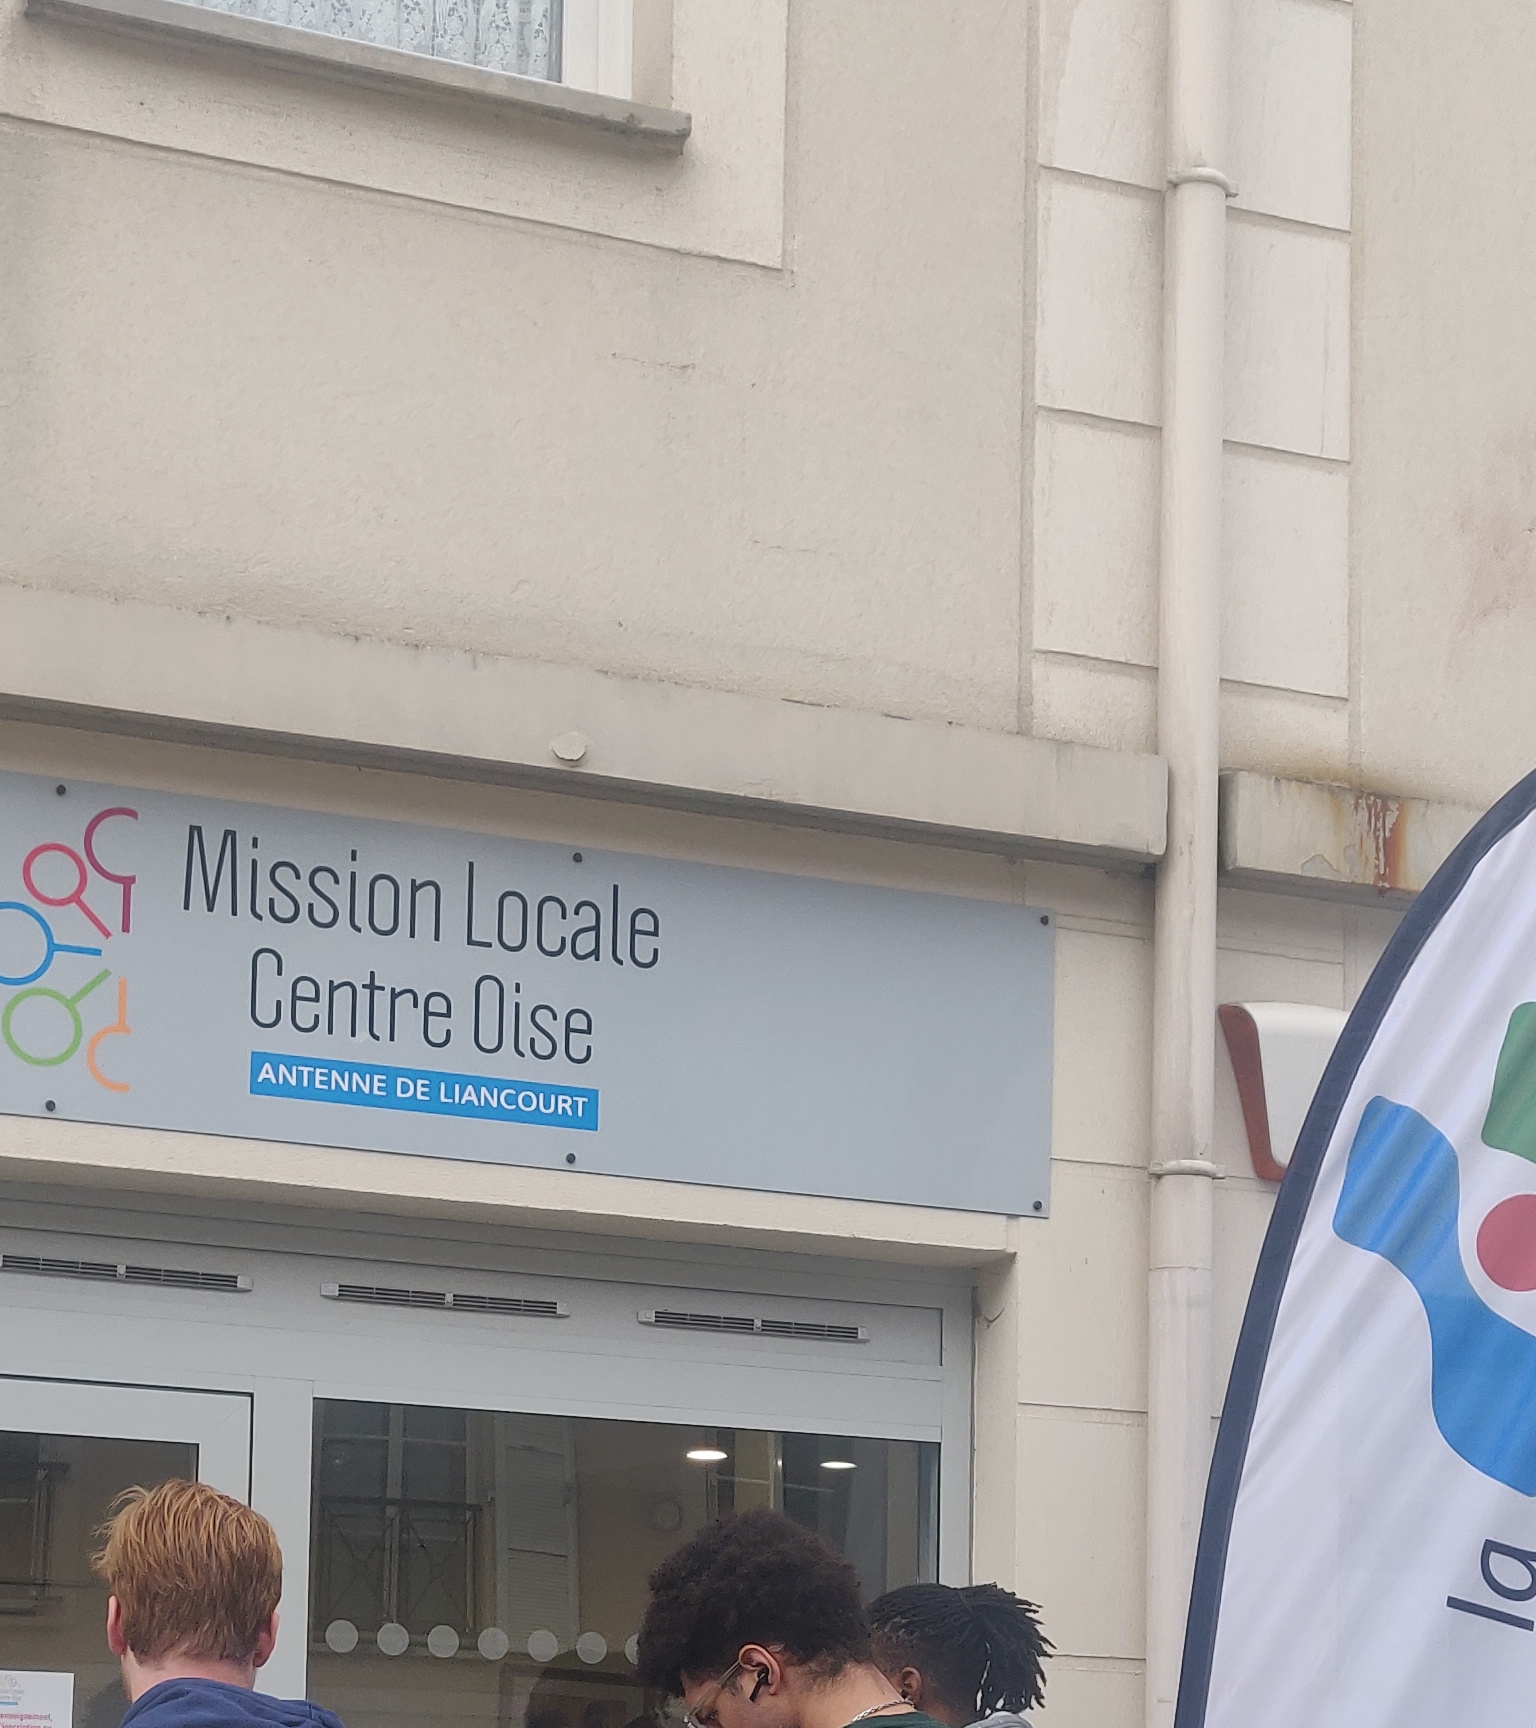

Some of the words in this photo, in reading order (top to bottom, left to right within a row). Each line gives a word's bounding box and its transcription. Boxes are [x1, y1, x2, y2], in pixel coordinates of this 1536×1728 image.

[183, 824, 441, 941] Mission
[466, 861, 661, 969] Locale
[250, 947, 452, 1049] Centre
[473, 974, 593, 1065] Oise
[257, 1062, 388, 1098] ANTENNE
[396, 1076, 432, 1102] DE
[439, 1081, 589, 1119] LIANCOURT
